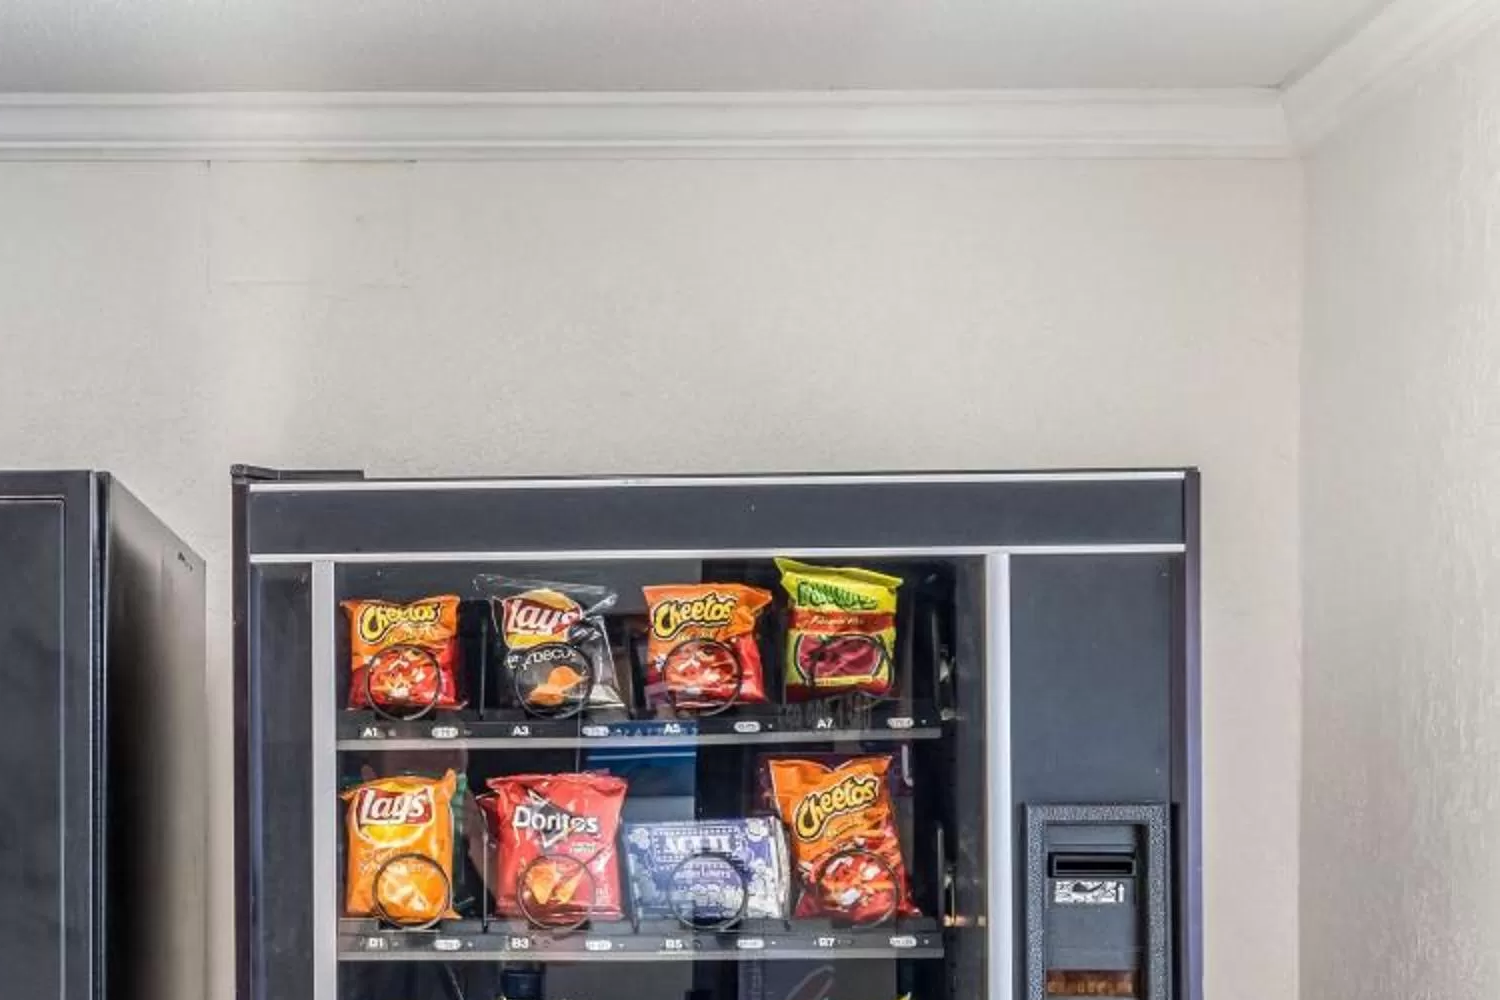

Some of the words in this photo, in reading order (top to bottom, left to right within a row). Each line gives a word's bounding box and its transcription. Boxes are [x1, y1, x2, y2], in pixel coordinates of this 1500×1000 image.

[360, 603, 439, 642] Cheetos
[655, 594, 735, 638] Cheetos
[363, 727, 377, 737] A1
[512, 724, 529, 735] A3
[818, 718, 833, 729] A7
[797, 776, 877, 838] Cheetos
[513, 805, 598, 832] Doritos
[512, 937, 529, 948] B3
